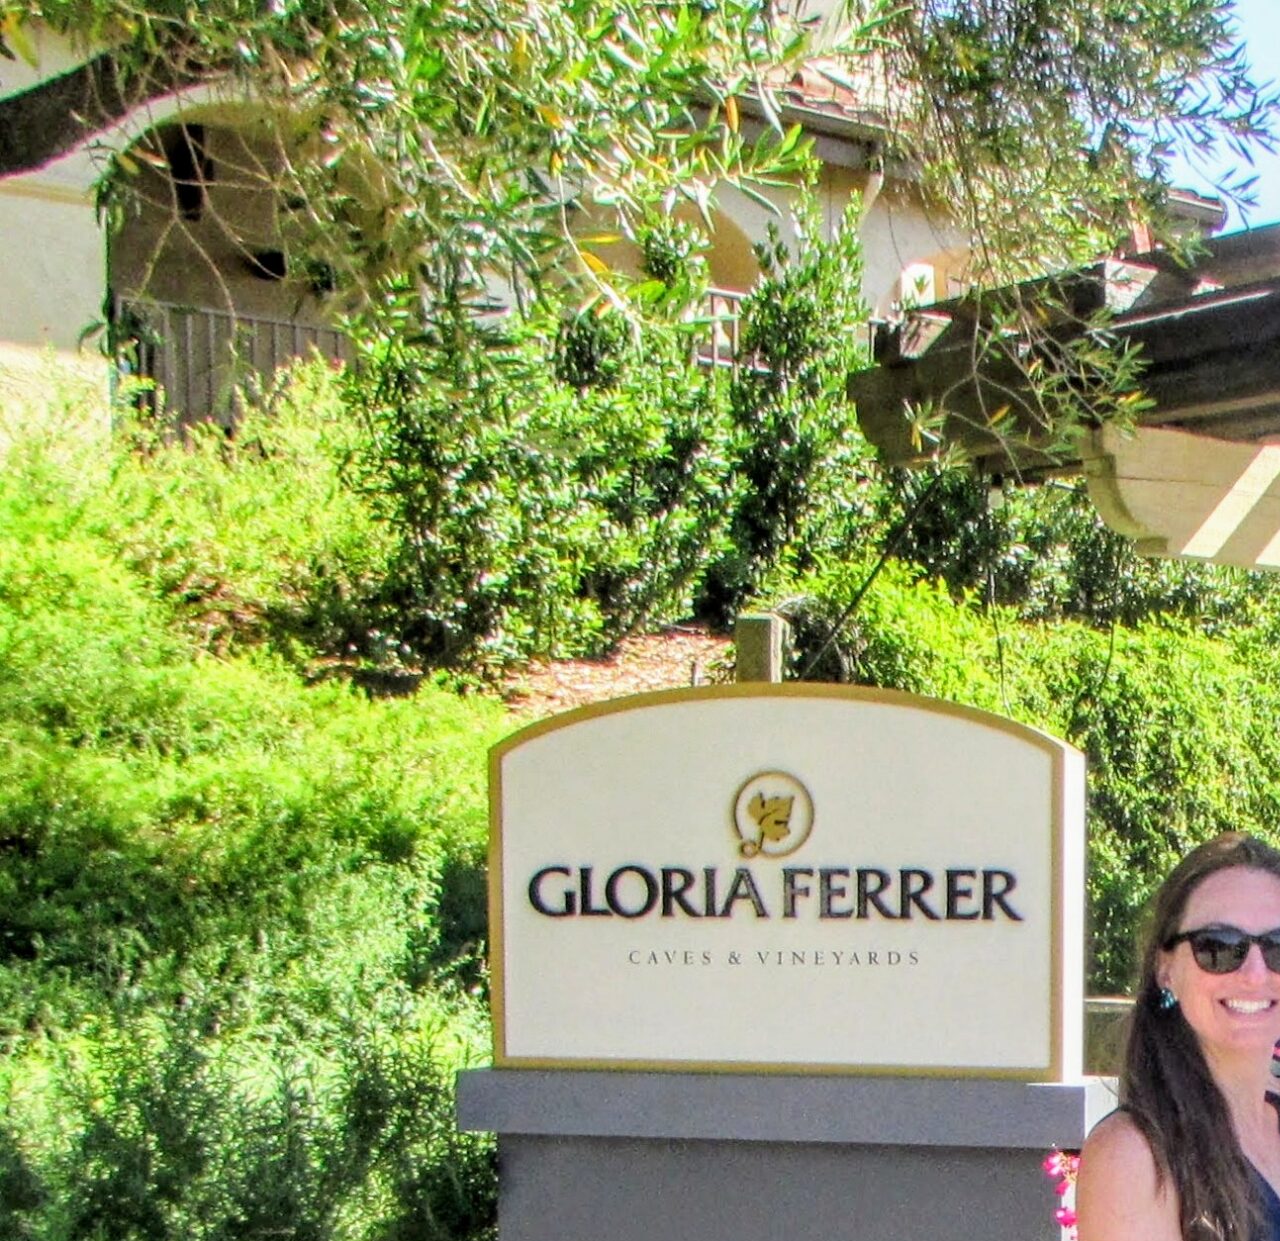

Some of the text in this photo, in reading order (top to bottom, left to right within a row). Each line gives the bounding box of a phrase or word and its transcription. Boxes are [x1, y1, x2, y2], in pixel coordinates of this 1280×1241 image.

[528, 865, 1024, 921] GLORIA FERRER
[628, 949, 920, 966] CAVES & VINEYARDS
